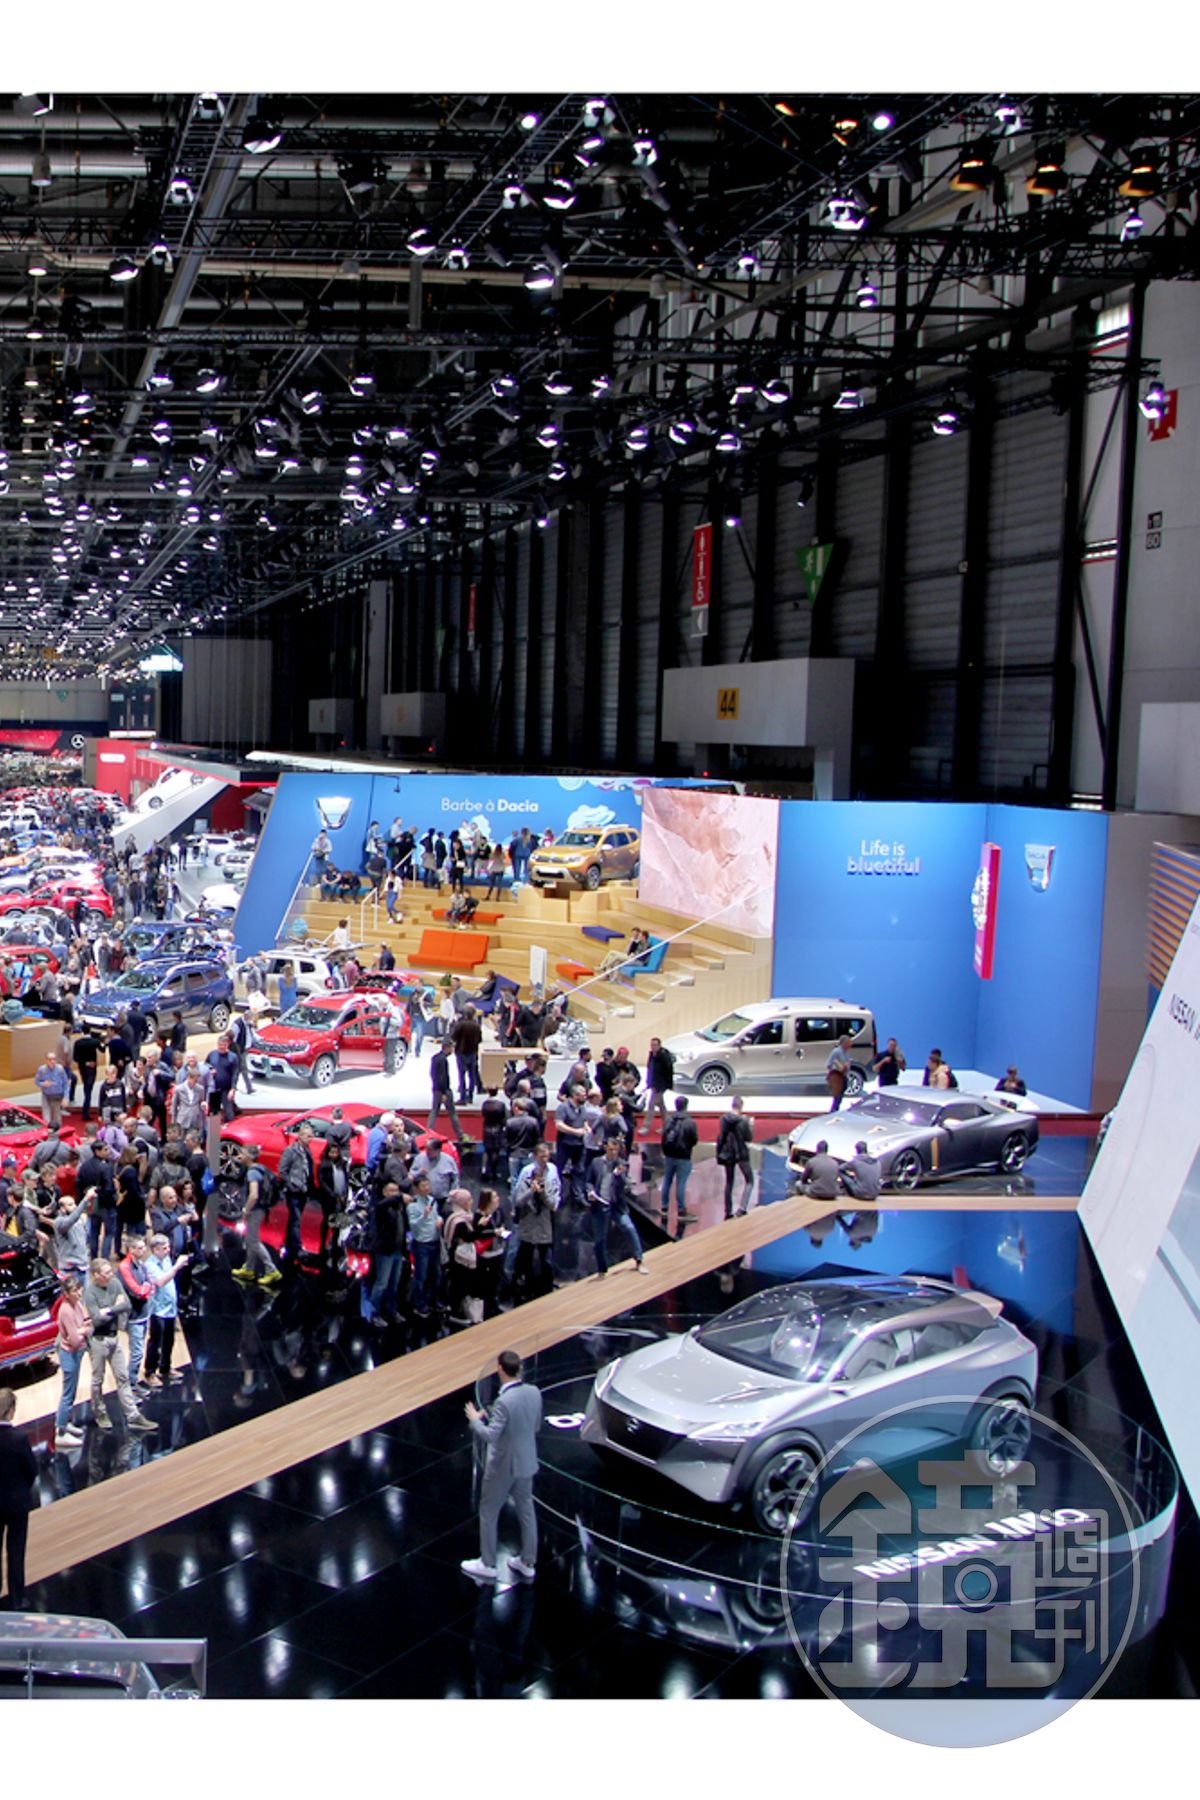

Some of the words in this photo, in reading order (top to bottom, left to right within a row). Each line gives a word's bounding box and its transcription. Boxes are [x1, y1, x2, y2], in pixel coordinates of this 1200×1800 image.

[719, 690, 737, 716] 44
[441, 798, 482, 812] Barbe
[485, 798, 496, 812] à
[497, 798, 539, 813] Dacia
[861, 839, 890, 856] Life
[893, 841, 905, 856] is
[847, 856, 920, 875] bluetiful
[853, 1534, 998, 1580] NISSAN
